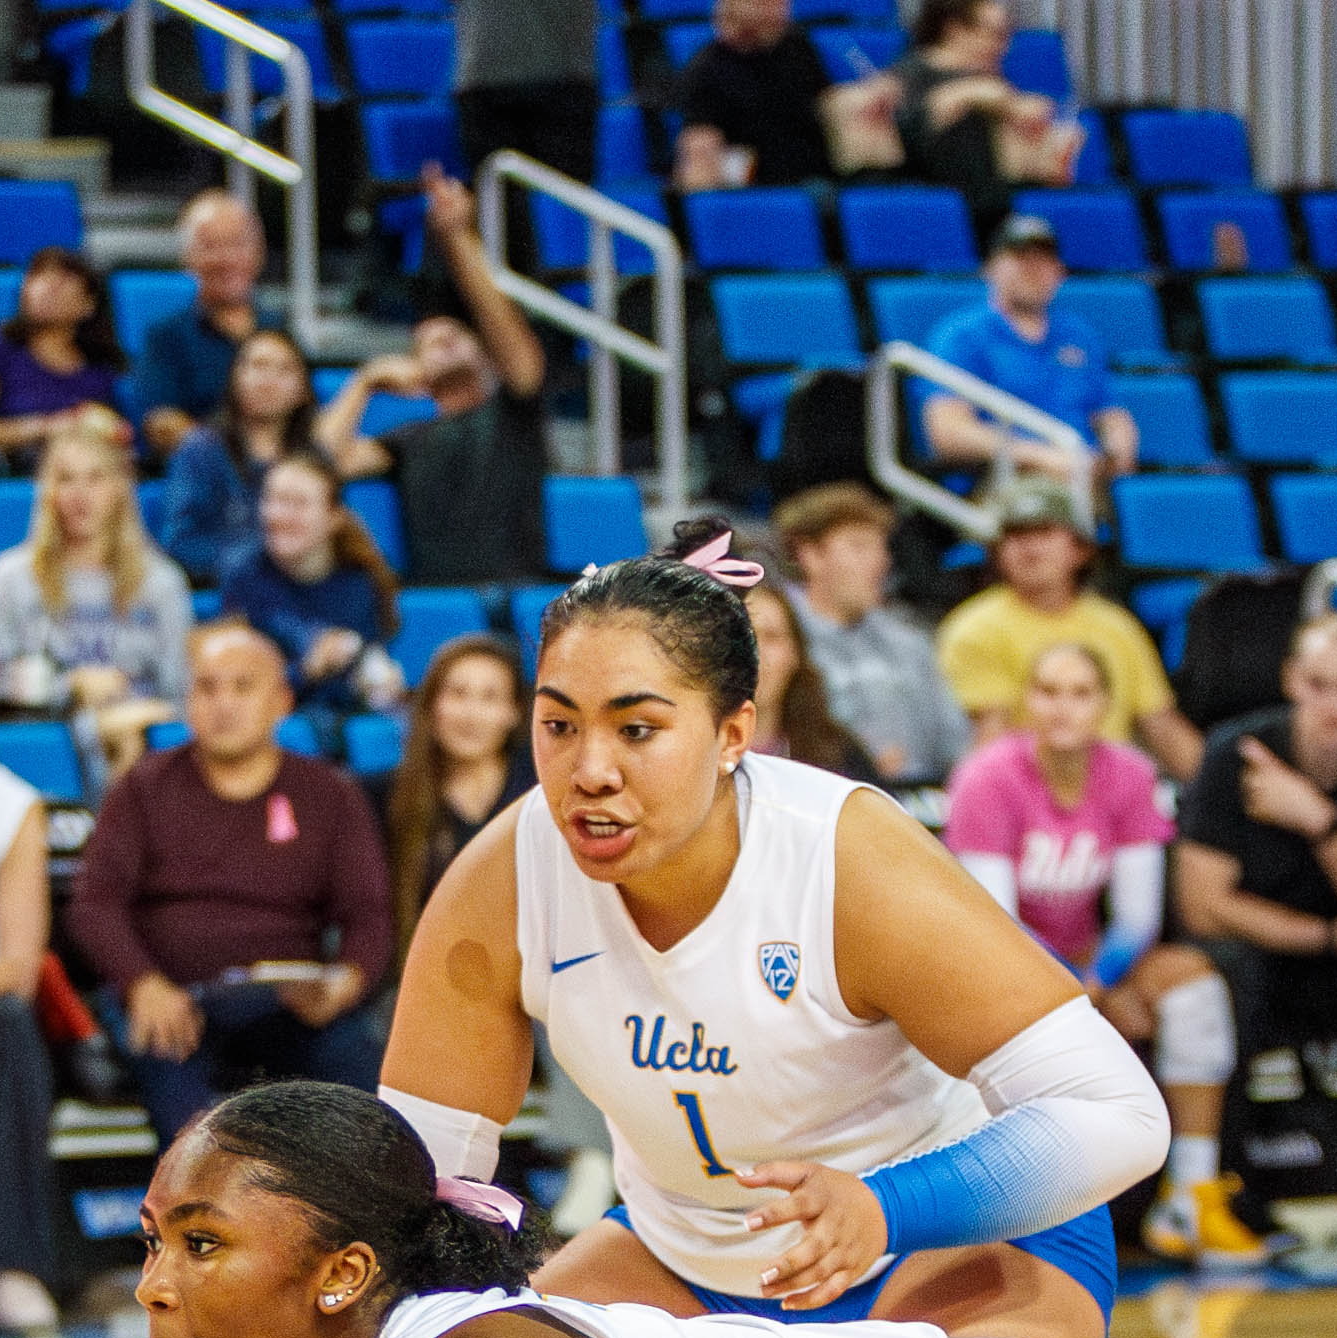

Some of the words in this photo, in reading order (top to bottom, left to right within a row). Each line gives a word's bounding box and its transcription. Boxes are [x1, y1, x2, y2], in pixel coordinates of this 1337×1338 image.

[759, 943, 800, 978] PAC
[769, 968, 792, 992] 12
[624, 1013, 739, 1077] Ucla
[672, 1089, 736, 1181] 1
